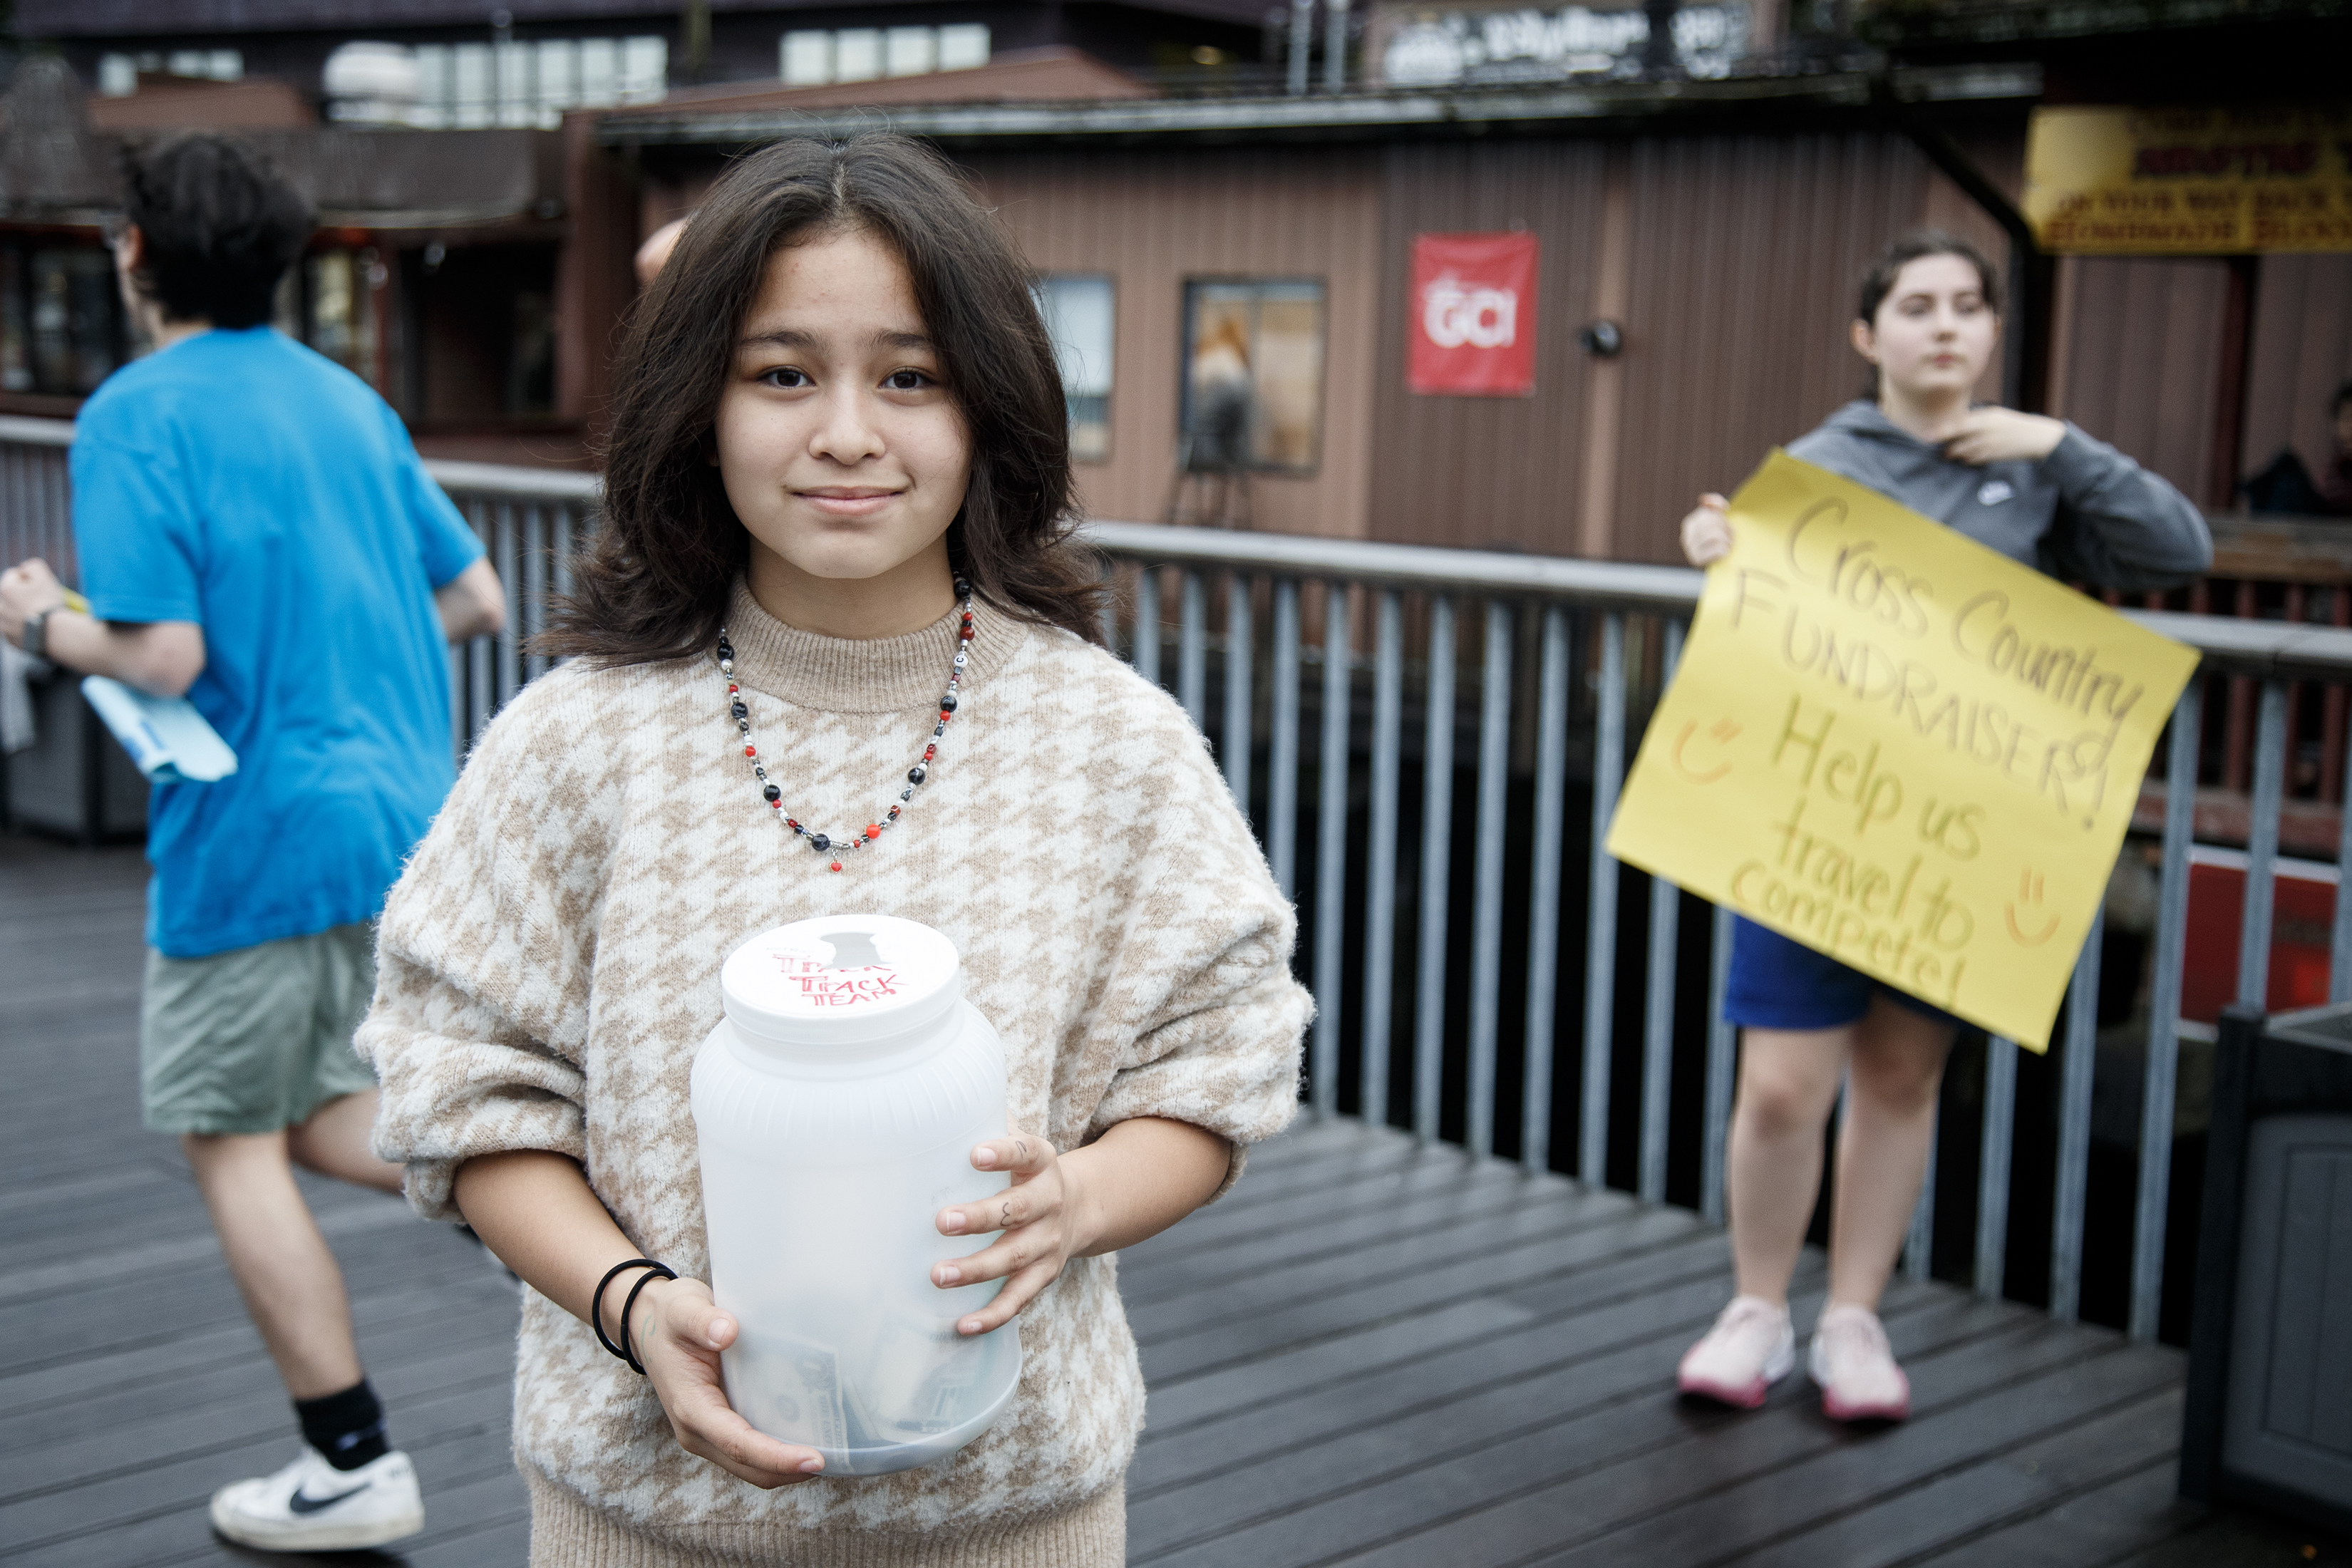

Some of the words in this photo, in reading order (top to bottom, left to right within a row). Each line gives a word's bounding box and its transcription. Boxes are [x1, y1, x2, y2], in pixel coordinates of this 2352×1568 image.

[1785, 495, 1934, 640] Cross
[1950, 589, 2145, 777] Country
[1770, 692, 1904, 837] Help
[1917, 795, 1986, 863] us
[1770, 795, 1923, 922] travel
[1919, 876, 1976, 952] to
